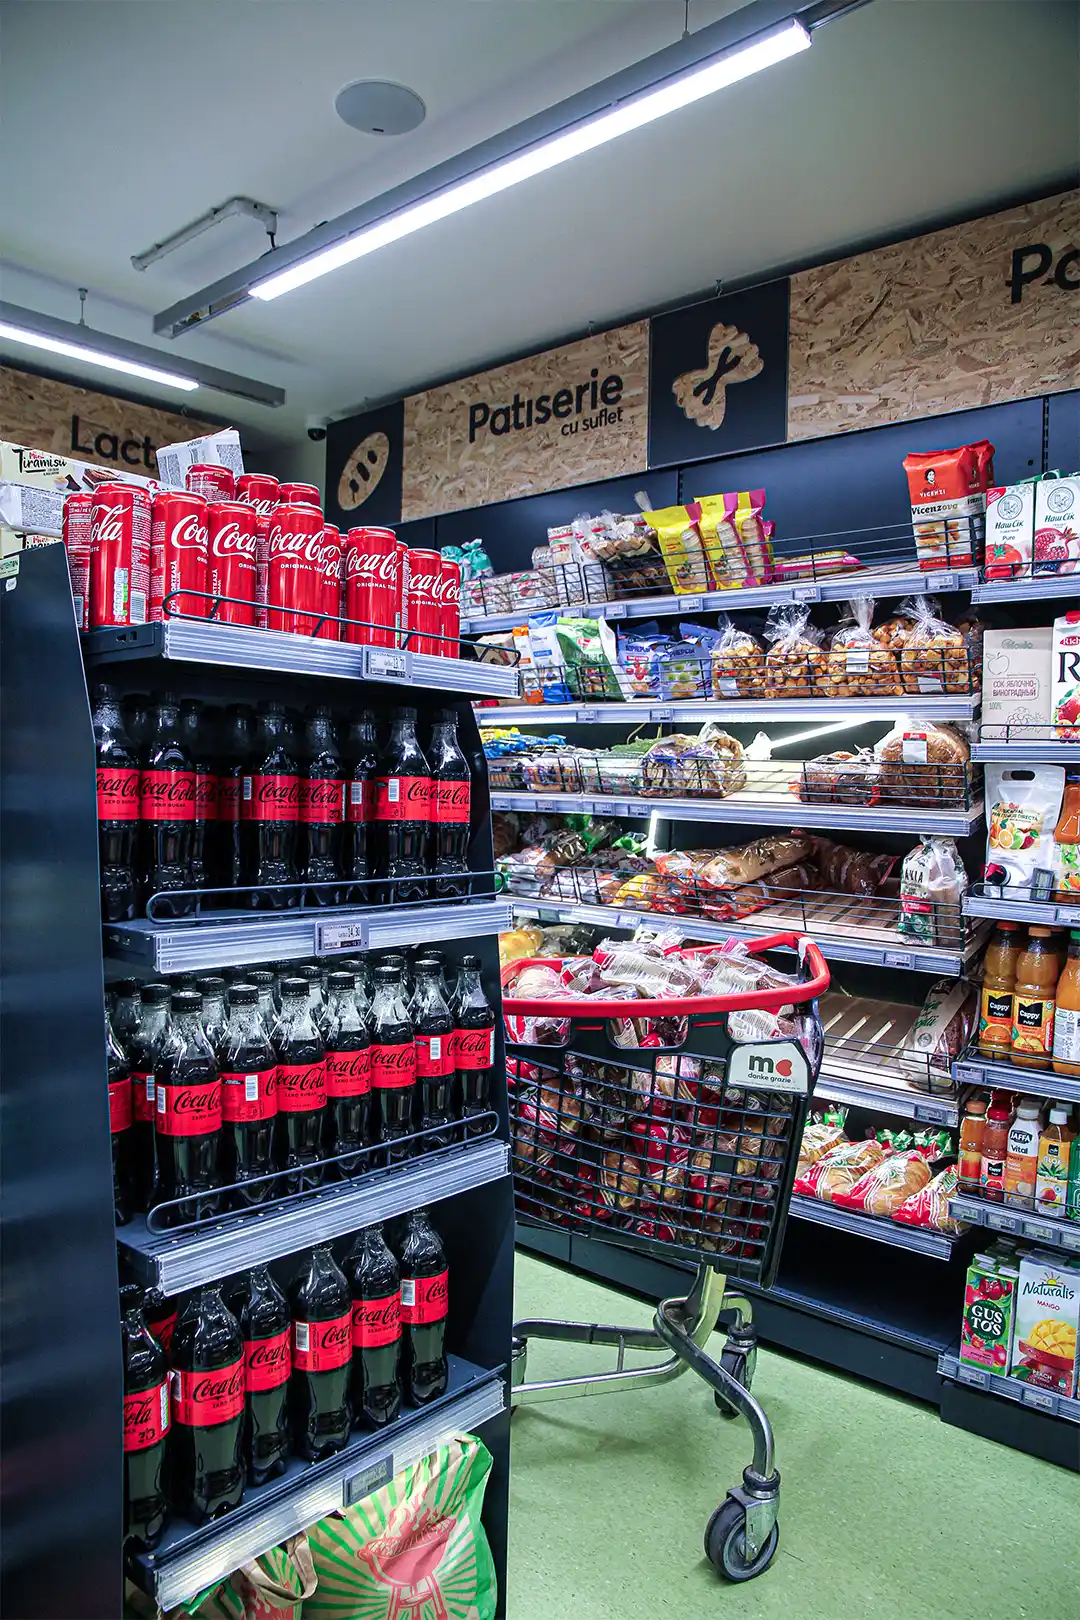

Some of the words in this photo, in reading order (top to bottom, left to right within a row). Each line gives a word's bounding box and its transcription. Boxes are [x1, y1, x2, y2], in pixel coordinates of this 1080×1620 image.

[469, 368, 624, 443] Patiserie
[561, 422, 578, 436] cu
[582, 406, 623, 430] suflet
[992, 680, 1004, 688] СОК
[992, 687, 1037, 698] ВИНОГРАДНЫЙ
[990, 1002, 1010, 1012] Cappy
[1019, 1009, 1041, 1020] Cappy
[748, 1072, 769, 1081] danke
[770, 1075, 792, 1084] grazie
[1010, 1131, 1031, 1142] JAFFA
[1011, 1144, 1028, 1155] Vital
[1022, 1280, 1075, 1300] Naturalis
[1036, 1299, 1061, 1311] MANGO
[971, 1304, 1003, 1324] GUS
[1032, 1368, 1053, 1381] PEACH
